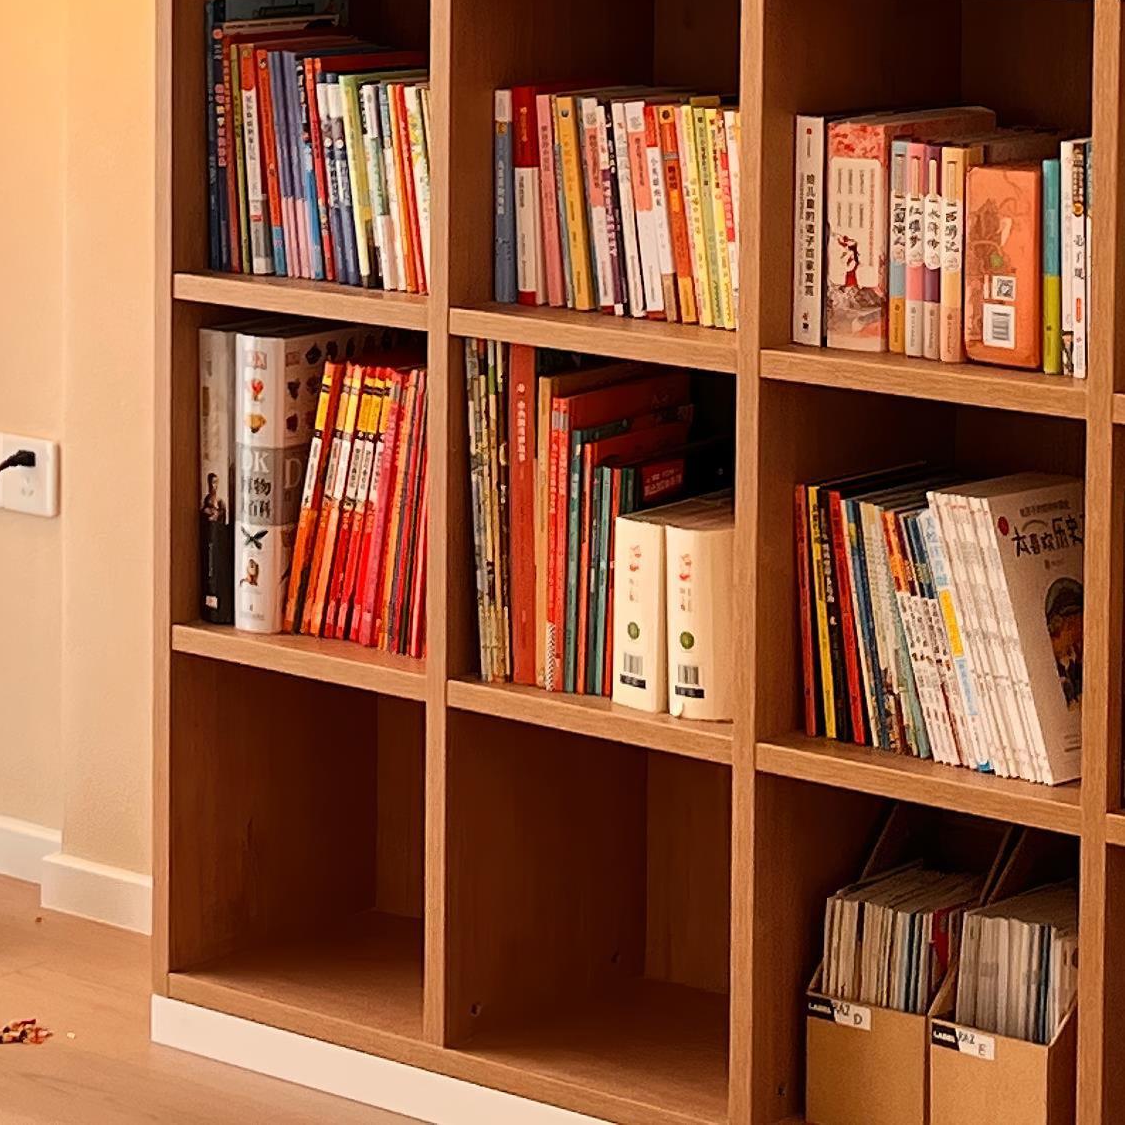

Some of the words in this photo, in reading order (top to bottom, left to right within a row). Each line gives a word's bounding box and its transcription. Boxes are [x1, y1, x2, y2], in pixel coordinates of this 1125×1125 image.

[945, 211, 959, 252] 西游记
[1011, 514, 1085, 557] 太喜欢历史
[853, 1013, 863, 1025] D
